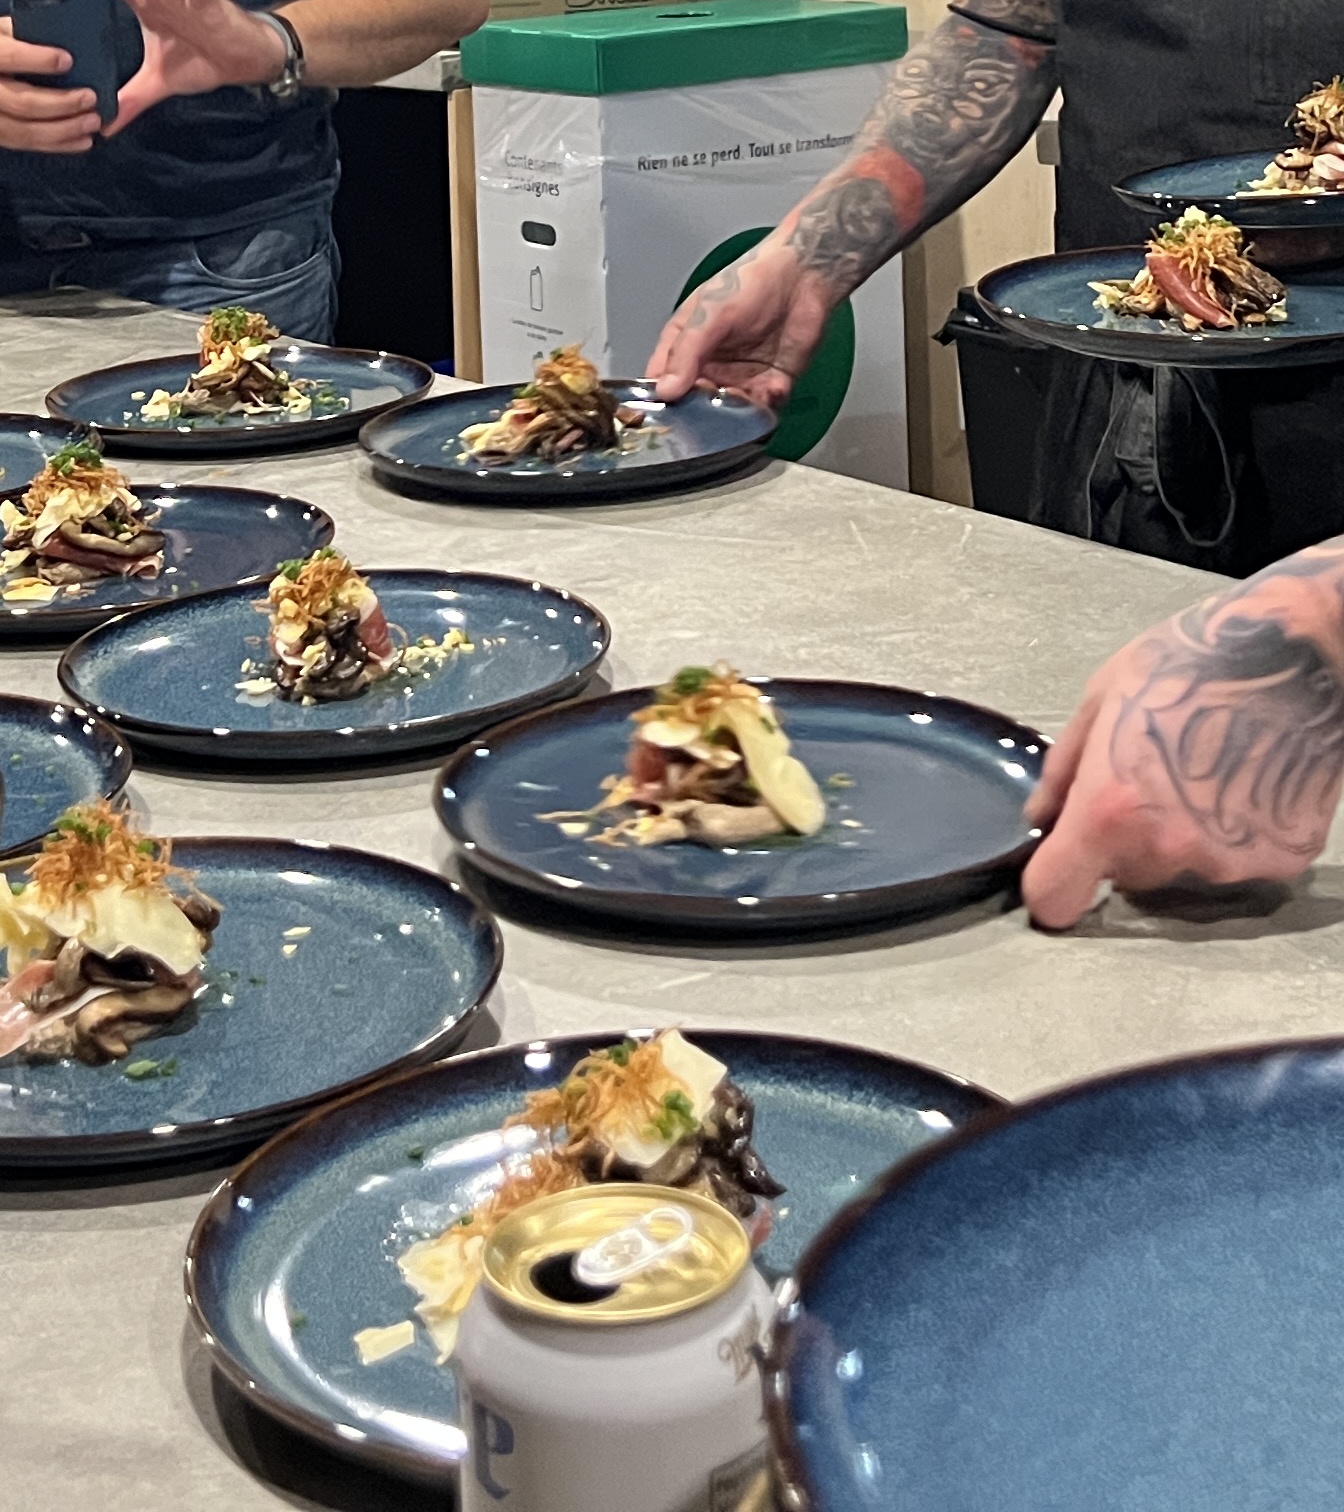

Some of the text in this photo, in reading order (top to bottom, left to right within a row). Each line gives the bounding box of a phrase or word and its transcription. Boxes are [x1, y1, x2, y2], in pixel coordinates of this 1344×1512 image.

[638, 154, 668, 171] Rien
[672, 155, 688, 168] ne
[692, 153, 707, 166] se
[748, 141, 775, 158] Tout
[779, 142, 792, 155] se
